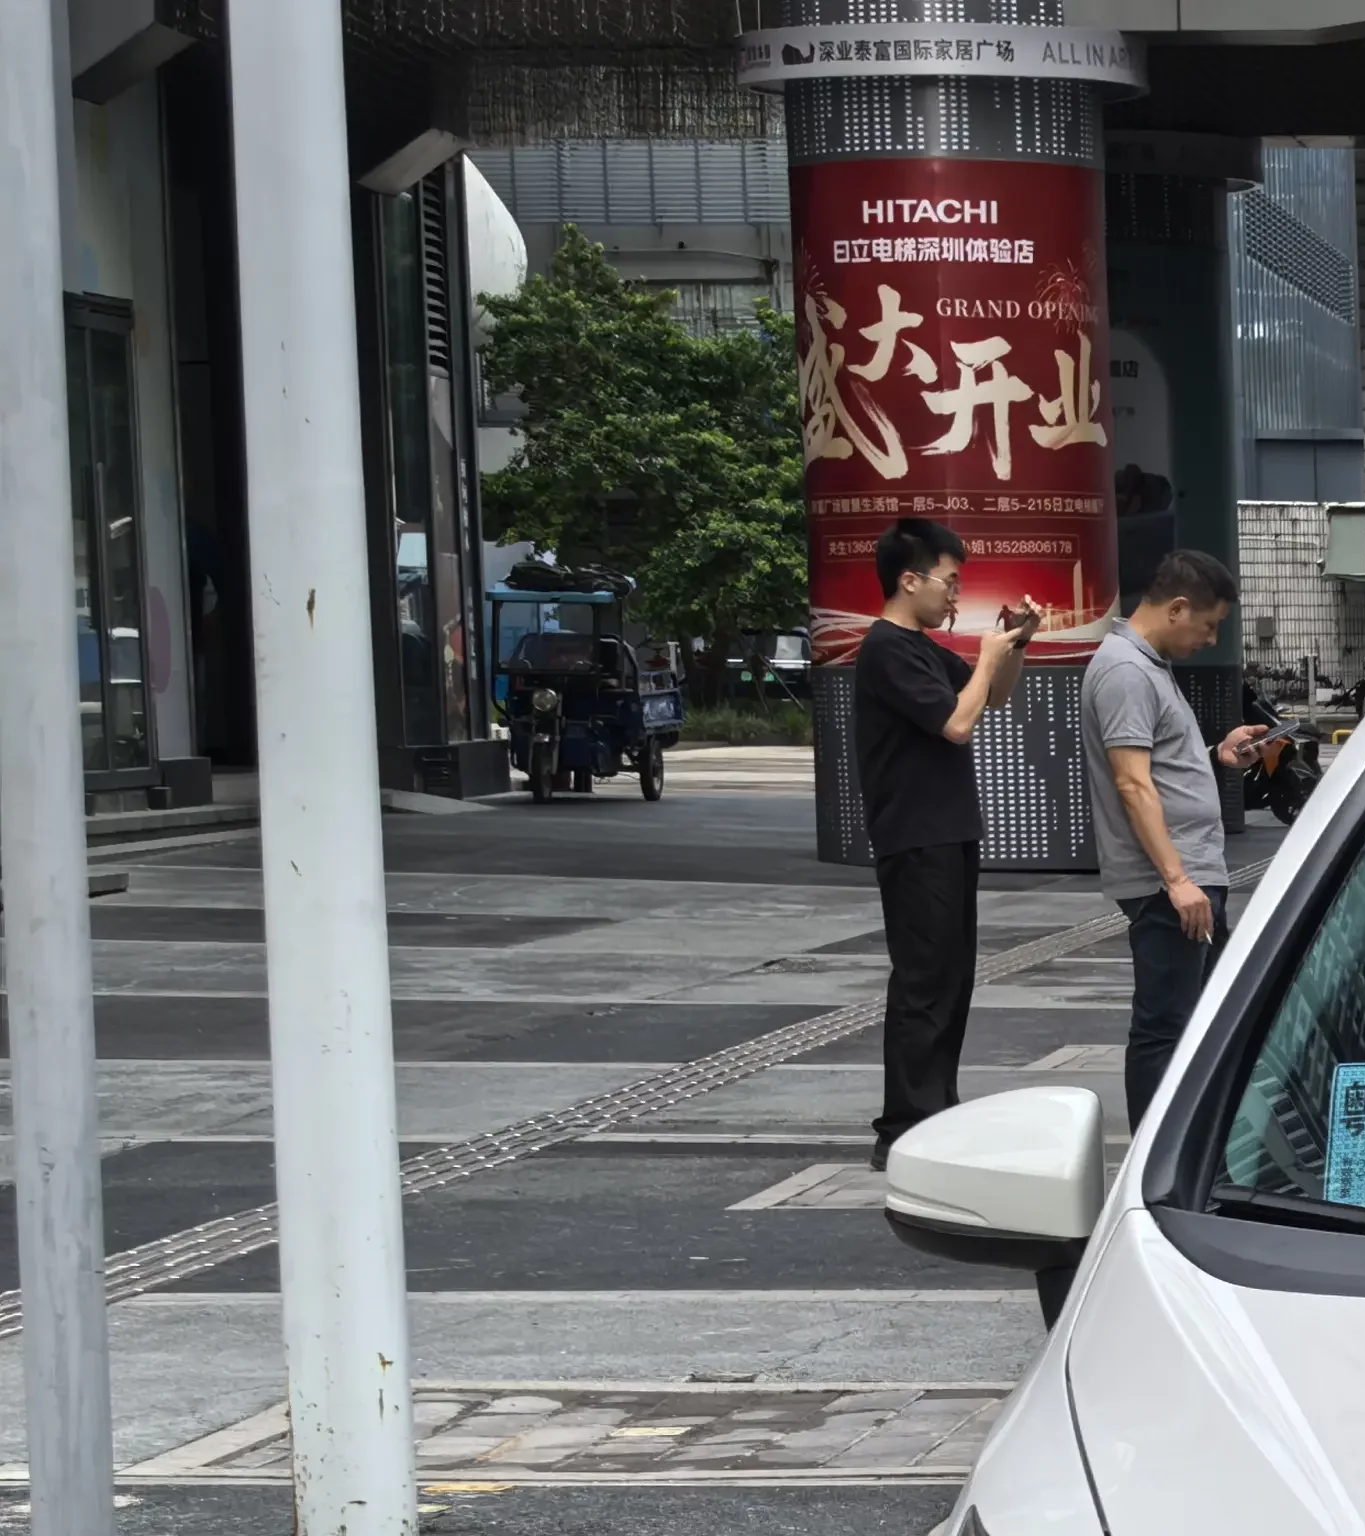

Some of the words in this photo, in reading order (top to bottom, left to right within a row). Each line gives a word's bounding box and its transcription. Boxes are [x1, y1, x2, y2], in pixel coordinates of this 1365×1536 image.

[819, 40, 1015, 63] 深业泰富国际家居广场
[1042, 40, 1082, 65] ALL
[1086, 43, 1104, 68] IN
[862, 200, 998, 225] HITACHI
[833, 237, 1035, 265] 日立电梯深圳体验店
[936, 298, 1021, 319] GRAND
